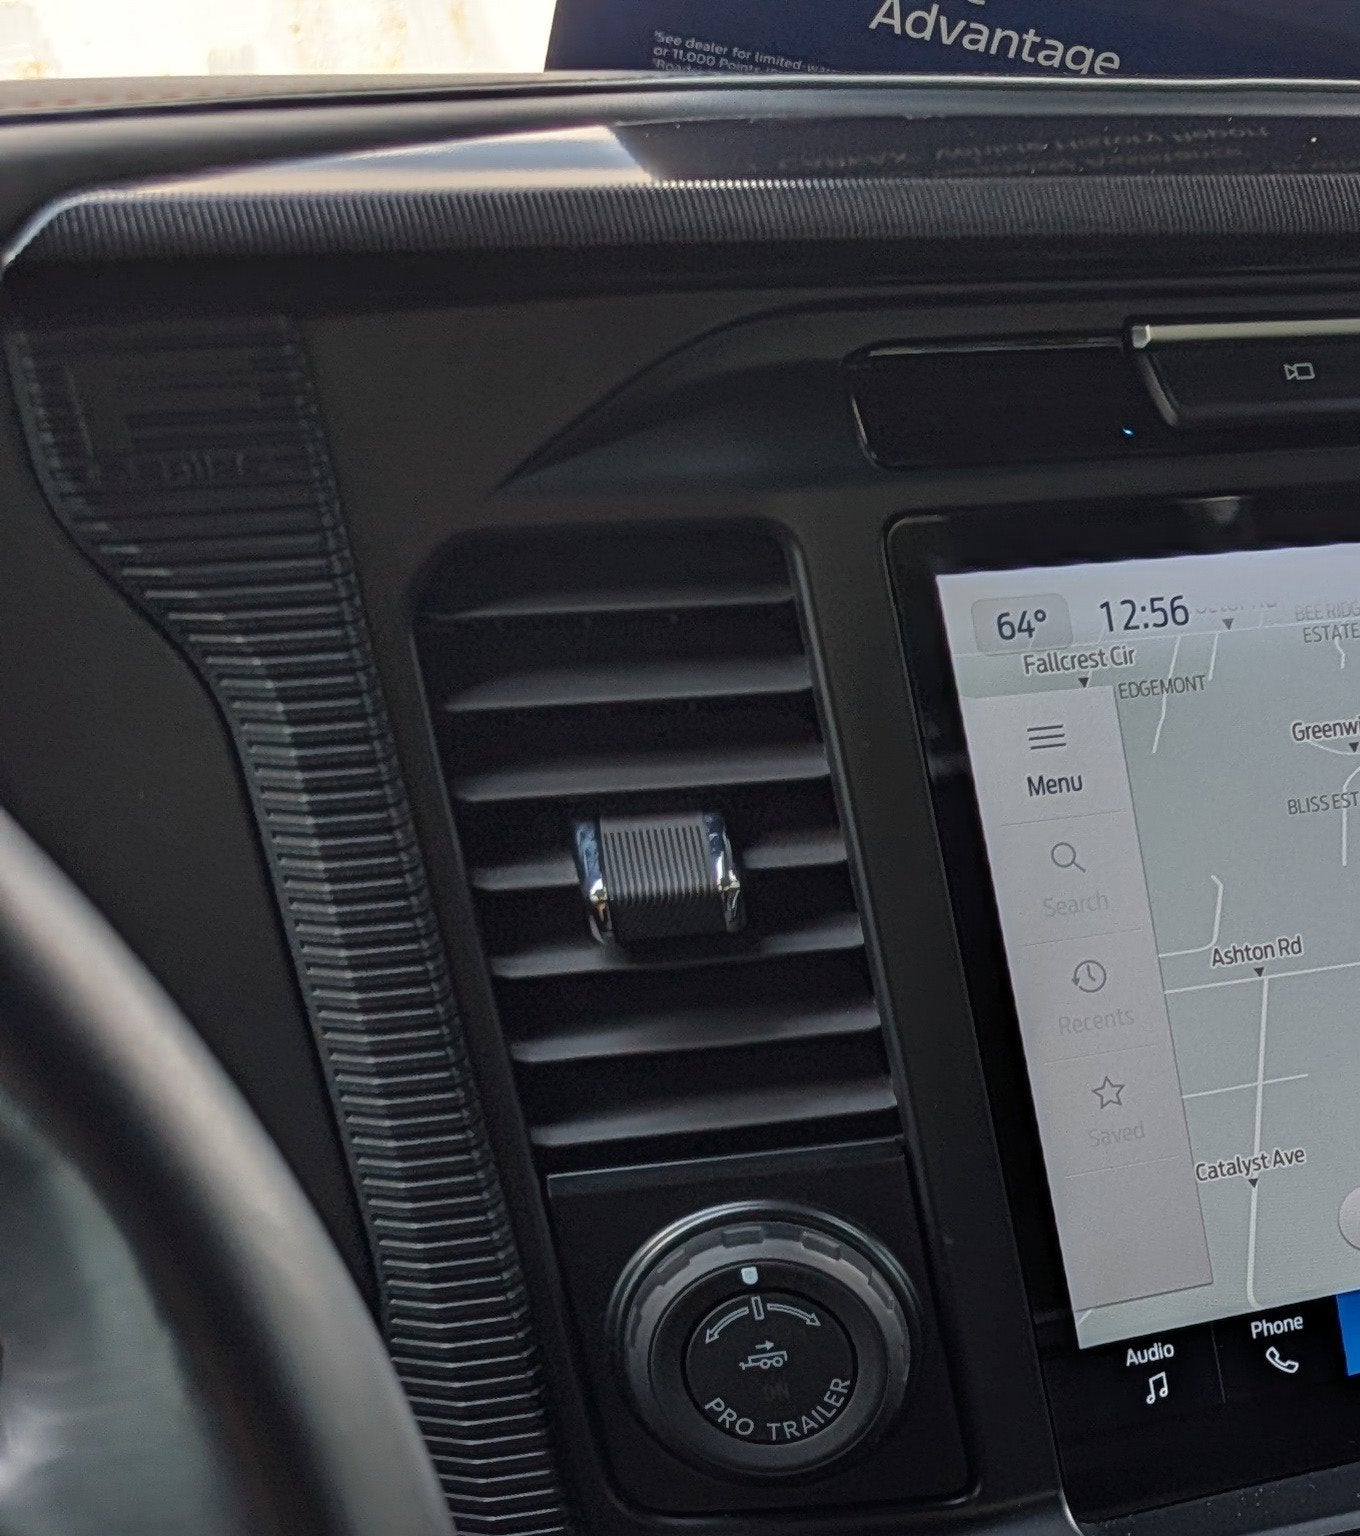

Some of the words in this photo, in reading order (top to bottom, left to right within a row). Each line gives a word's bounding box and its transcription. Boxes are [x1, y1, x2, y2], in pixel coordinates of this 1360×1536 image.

[869, 0, 1120, 75] Advantage
[685, 38, 728, 55] dealer
[732, 47, 751, 60] for
[754, 52, 803, 70] limited
[1100, 596, 1190, 633] 12:56
[1023, 650, 1106, 675] Fallcrest
[1109, 646, 1135, 667] Cir
[1119, 676, 1206, 700] EDGEMONT
[1027, 774, 1083, 797] Menu
[1288, 795, 1329, 815] BLISS
[1043, 892, 1109, 918] Search
[1212, 938, 1275, 967] Ashton
[1277, 935, 1302, 959] Rd
[1059, 1008, 1136, 1035] Recents
[1088, 1123, 1146, 1148] Saved
[1195, 1152, 1269, 1183] Catalyst
[1272, 1148, 1305, 1168] Ave
[1249, 1312, 1305, 1341] Phone
[1125, 1341, 1175, 1369] Audio
[704, 1397, 755, 1436] PRO
[766, 1377, 851, 1441] TRAILER
